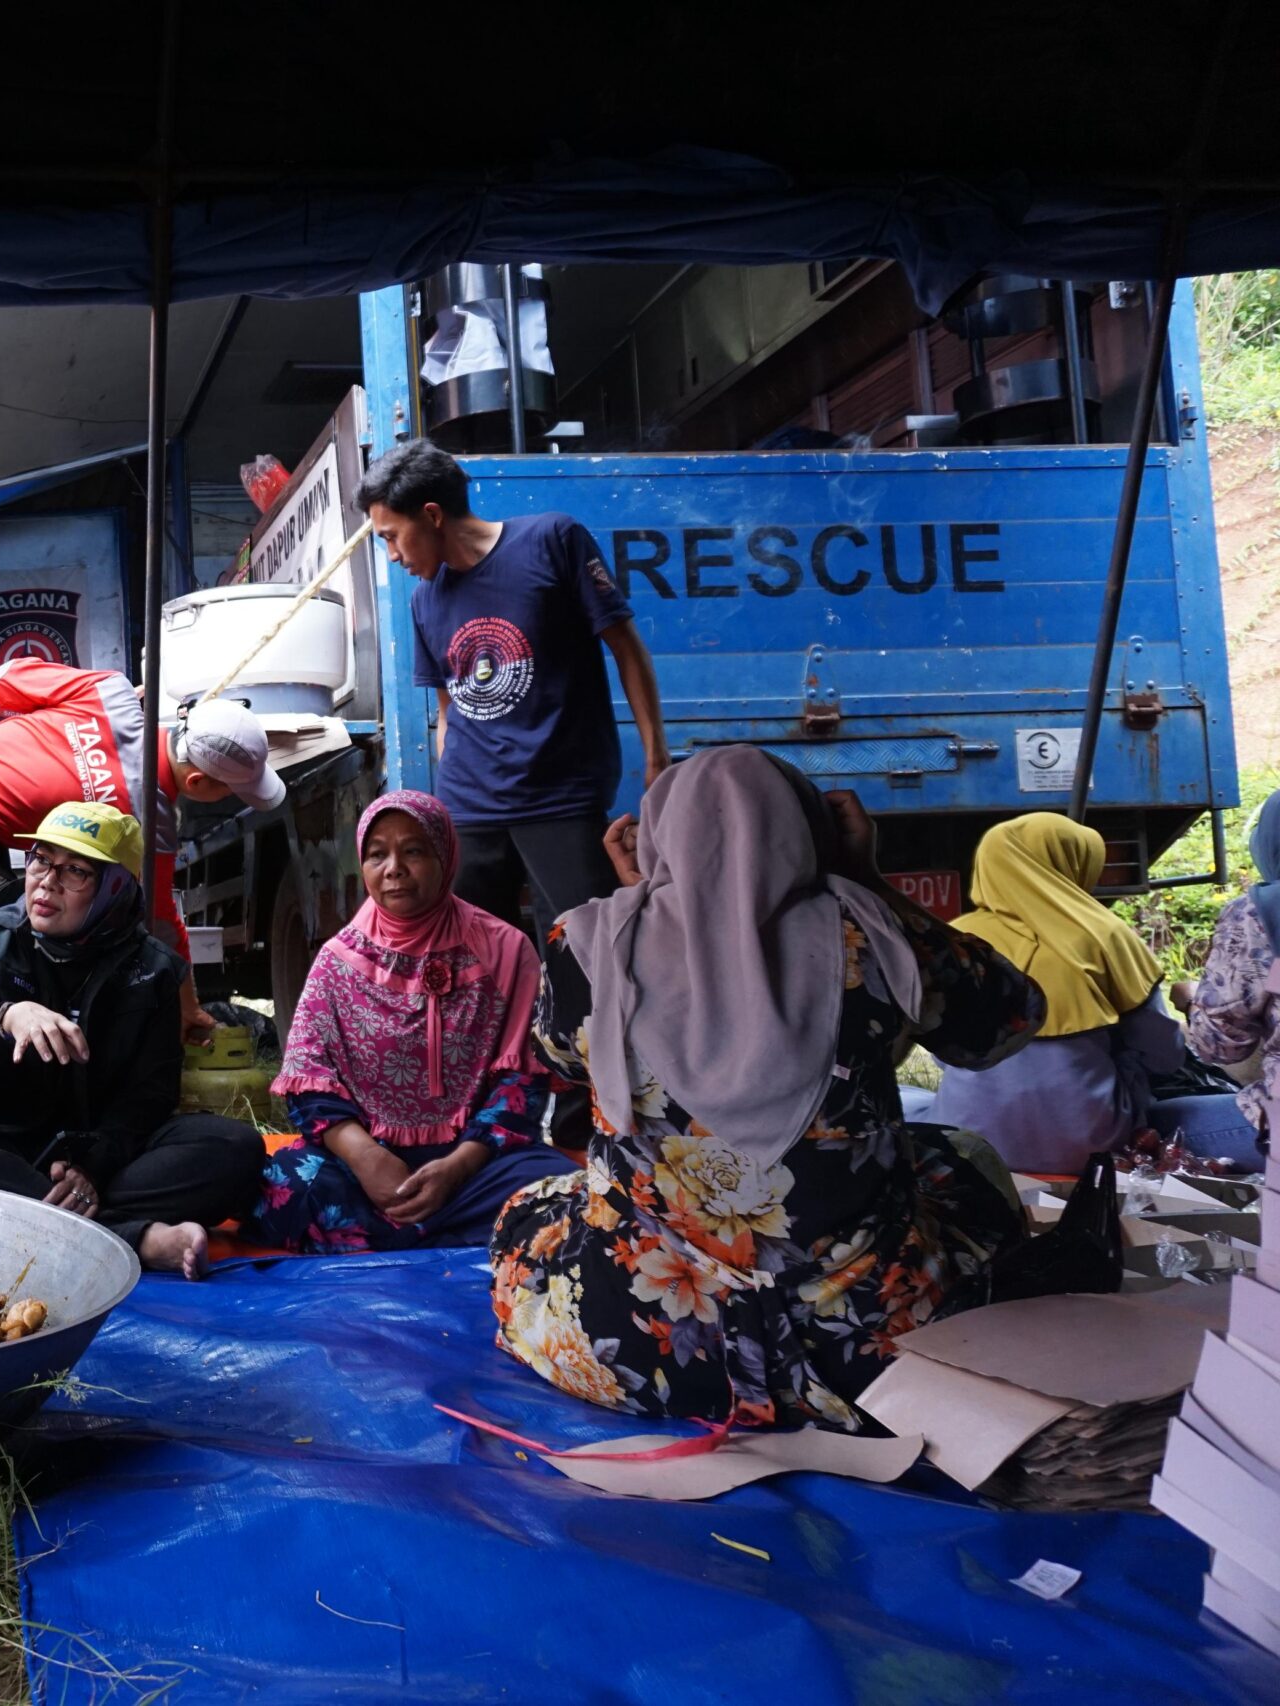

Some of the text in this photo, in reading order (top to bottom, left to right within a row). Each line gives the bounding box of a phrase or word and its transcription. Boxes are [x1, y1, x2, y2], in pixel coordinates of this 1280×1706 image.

[250, 552, 265, 583] NIT
[266, 515, 296, 580] DAPUR
[612, 523, 1005, 600] RESCUE
[6, 623, 40, 637] SIAGA
[41, 627, 71, 667] BENCAN
[77, 716, 118, 803] TAGAN
[82, 782, 92, 802] SOS
[50, 813, 102, 839] HOKA
